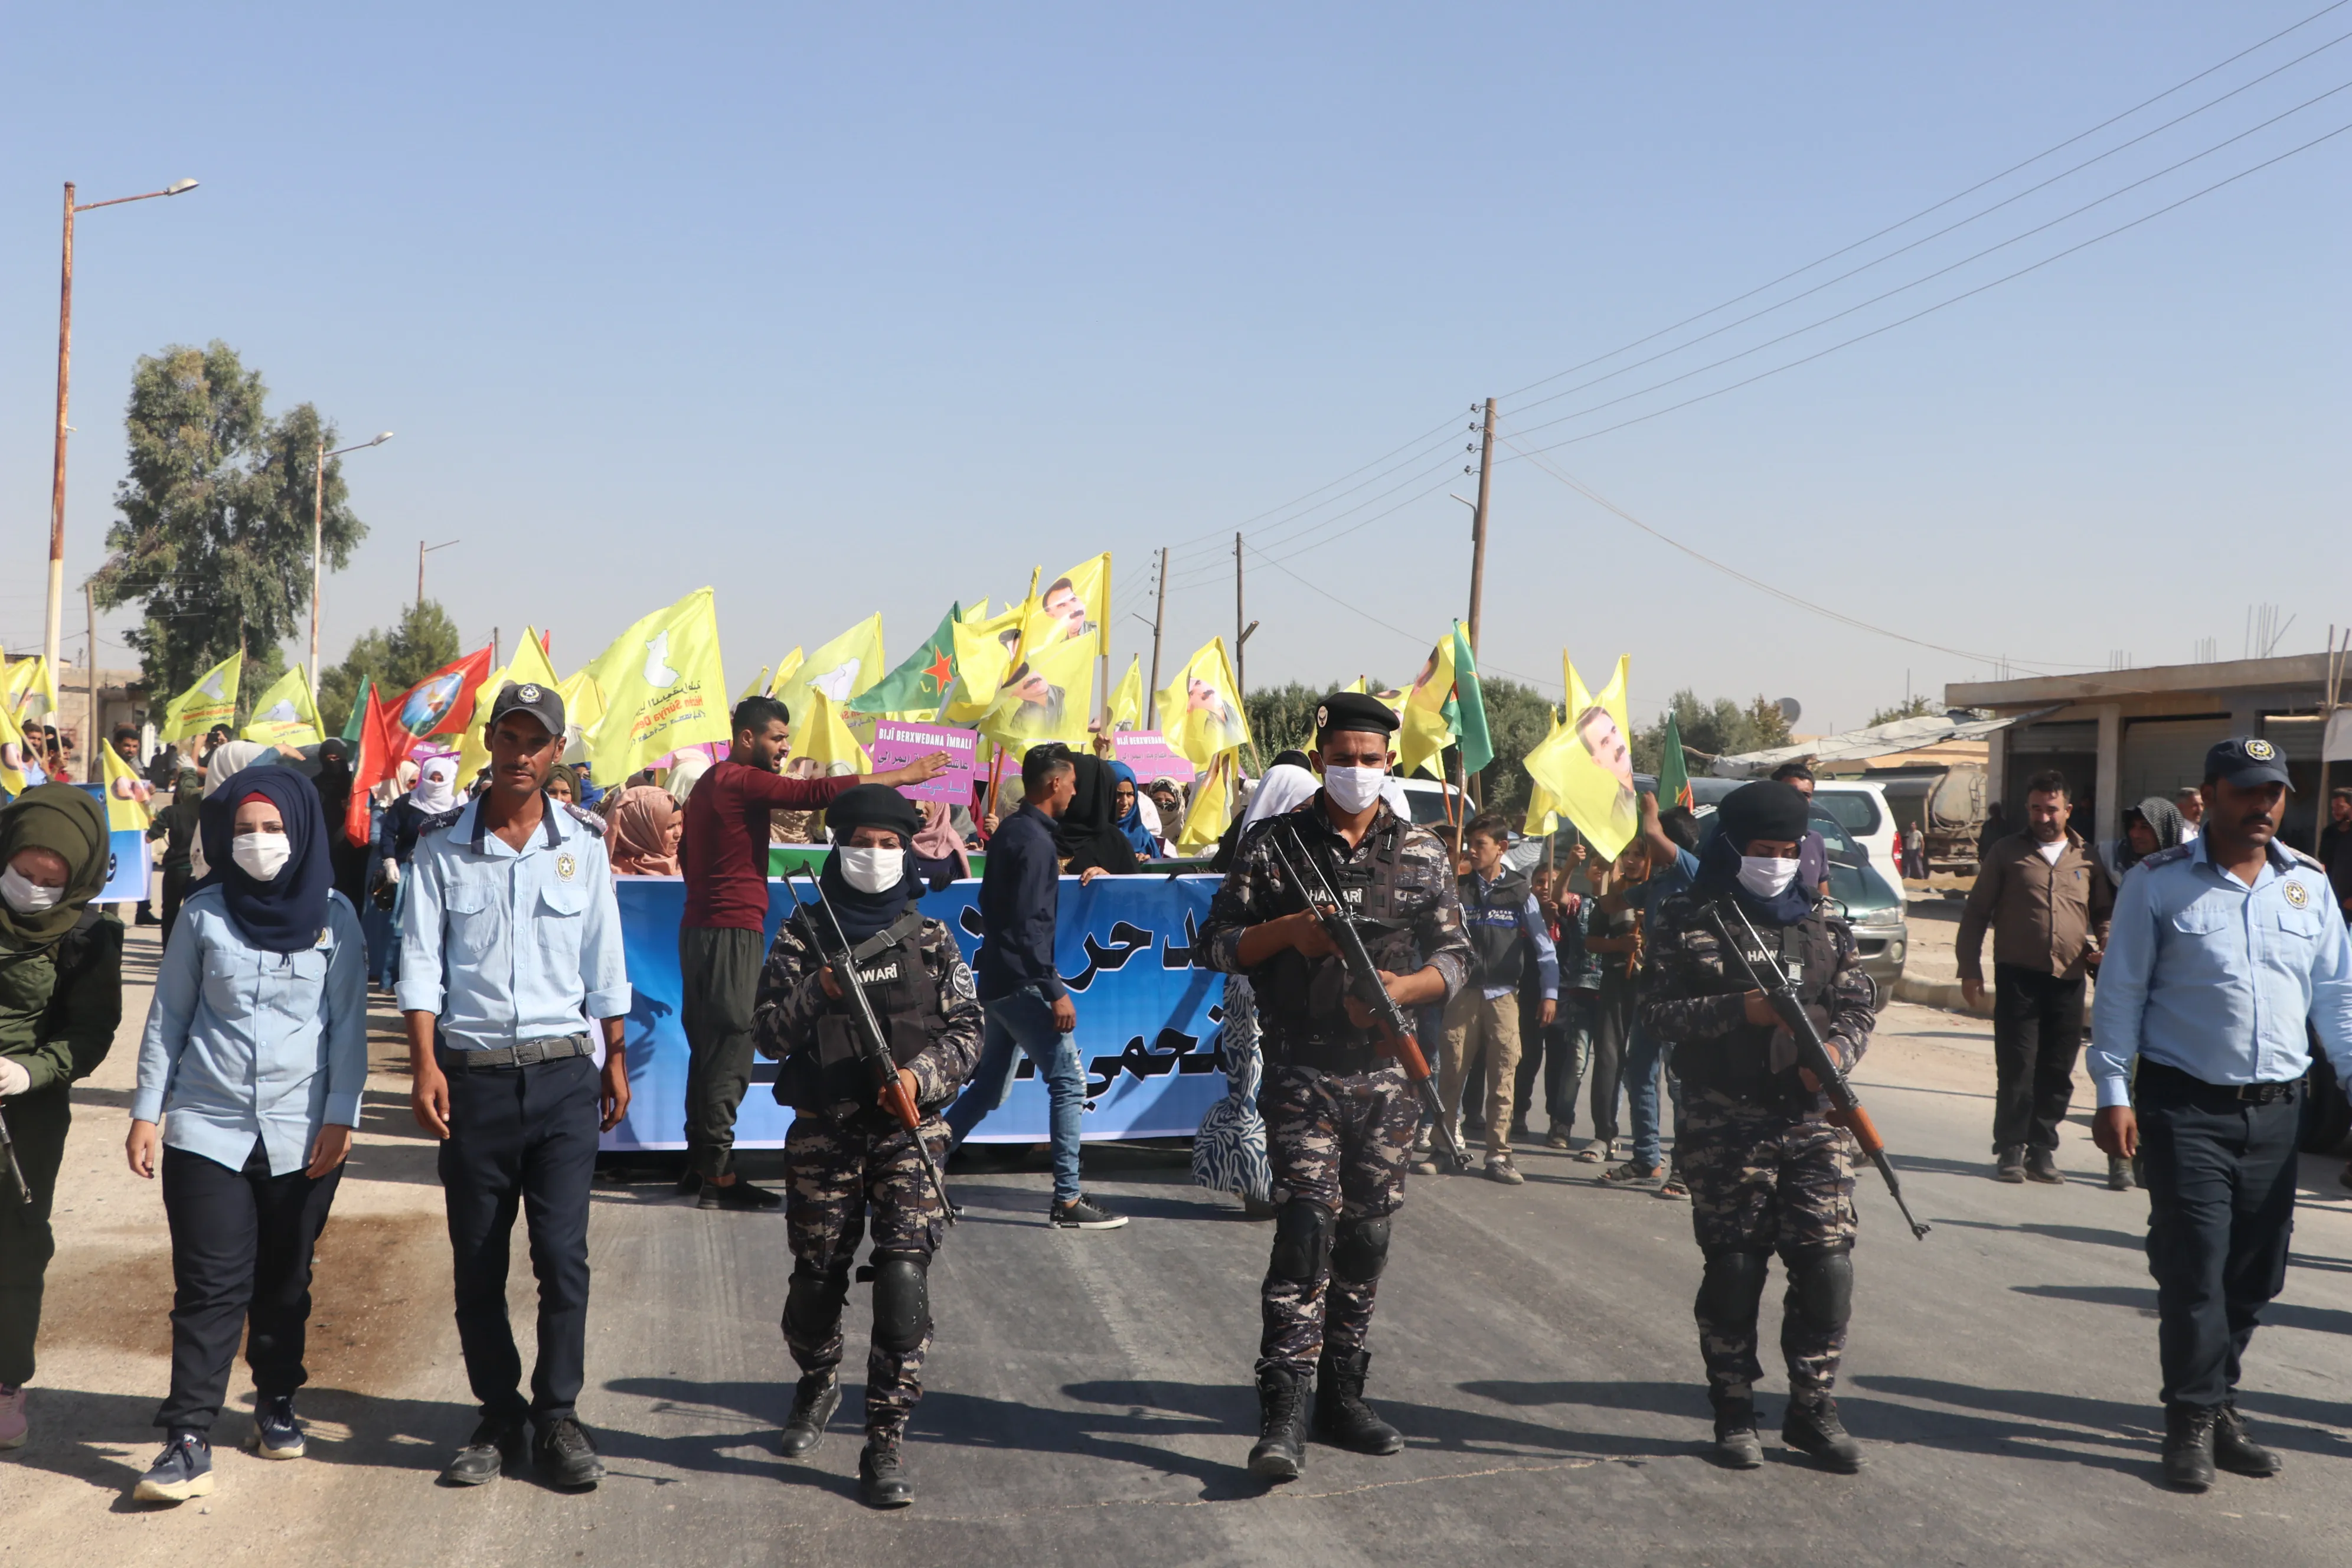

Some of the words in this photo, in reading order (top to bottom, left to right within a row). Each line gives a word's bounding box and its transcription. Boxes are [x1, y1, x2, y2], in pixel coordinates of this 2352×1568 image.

[879, 727, 894, 740] BIJÎ
[896, 730, 944, 746] BERXWEDANA
[946, 734, 972, 750] ÎMRALI
[1309, 887, 1363, 903] HAARÎ
[1747, 949, 1783, 962] HAW
[857, 962, 897, 984] WARÎ
